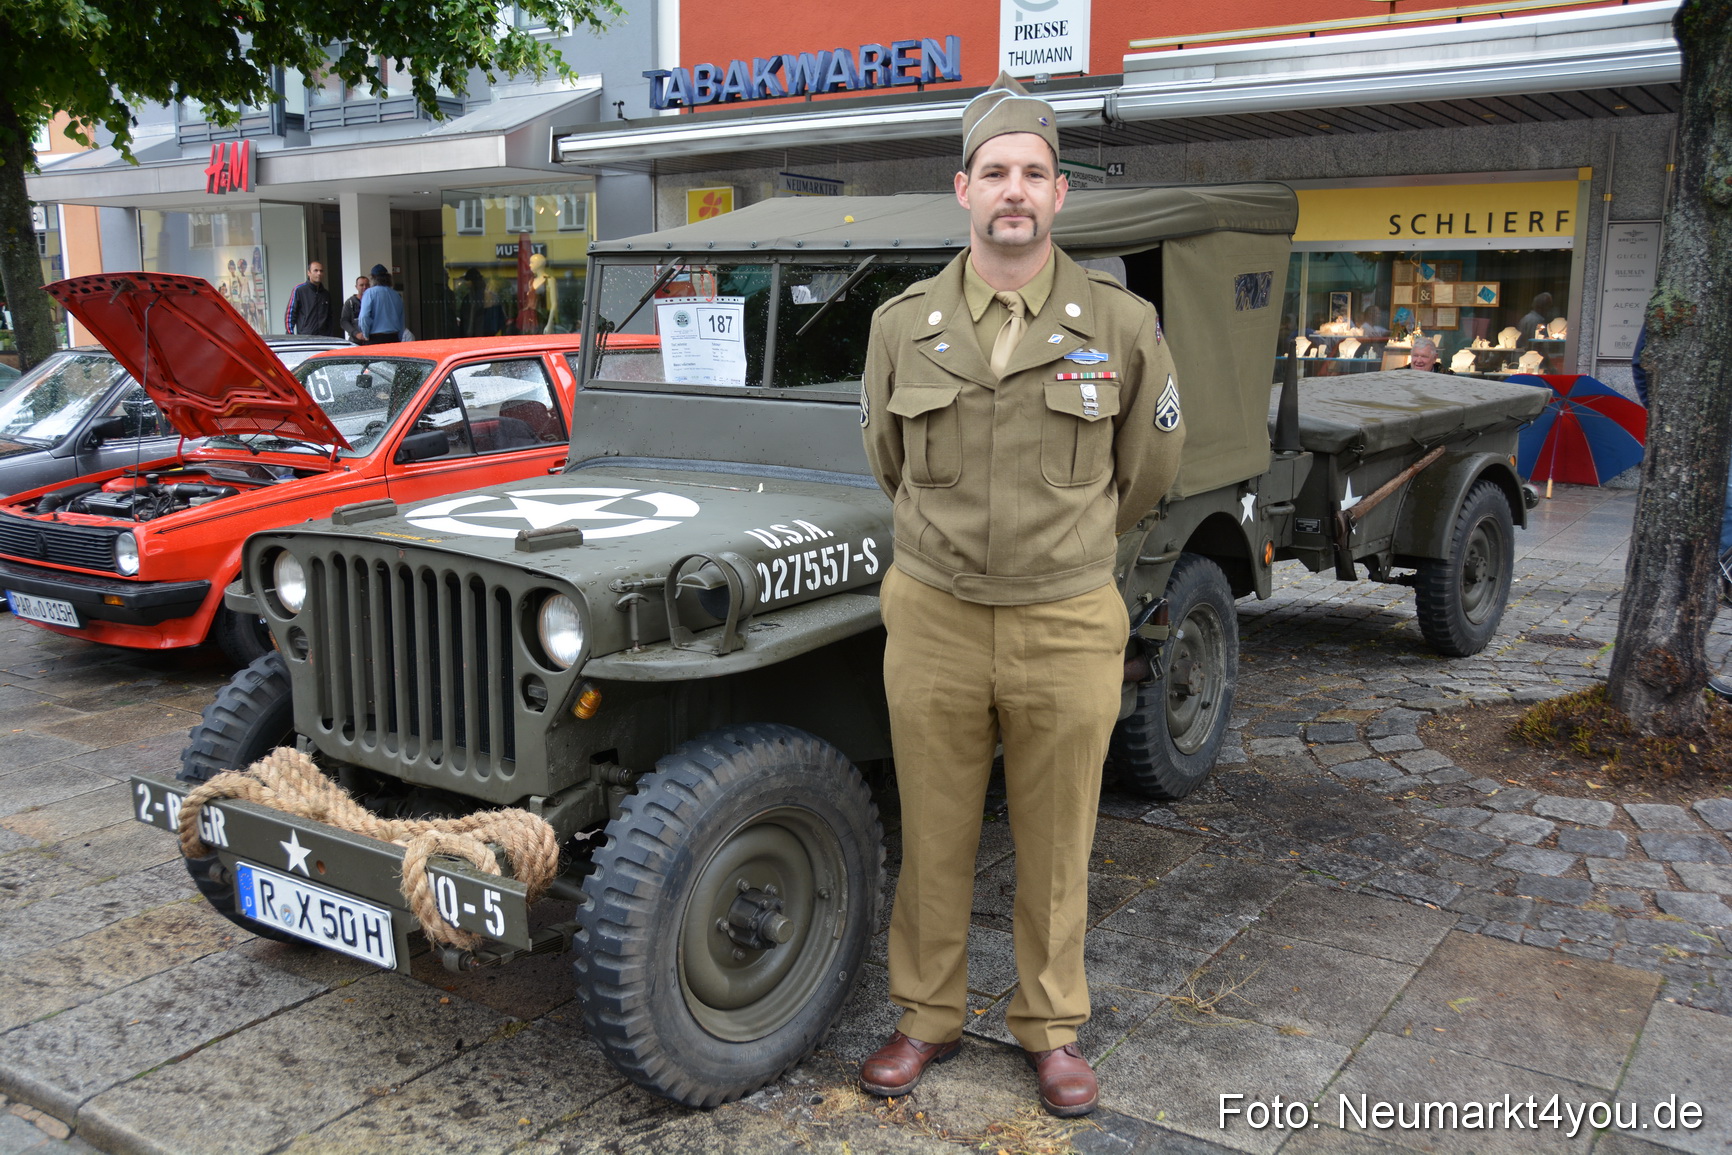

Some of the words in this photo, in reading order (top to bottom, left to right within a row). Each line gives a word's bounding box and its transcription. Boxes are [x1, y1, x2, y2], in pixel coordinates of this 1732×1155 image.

[1014, 20, 1068, 41] PRESSE
[1008, 46, 1073, 66] THUMANN
[642, 35, 962, 109] TABAKWAREN
[204, 139, 250, 194] H&M
[1108, 164, 1123, 175] 41
[786, 178, 838, 196] NEUMARKTER
[1389, 210, 1570, 235] SCHLIERF
[708, 314, 733, 333] 187
[743, 519, 835, 550] U.S.A.
[13, 595, 34, 616] PAR
